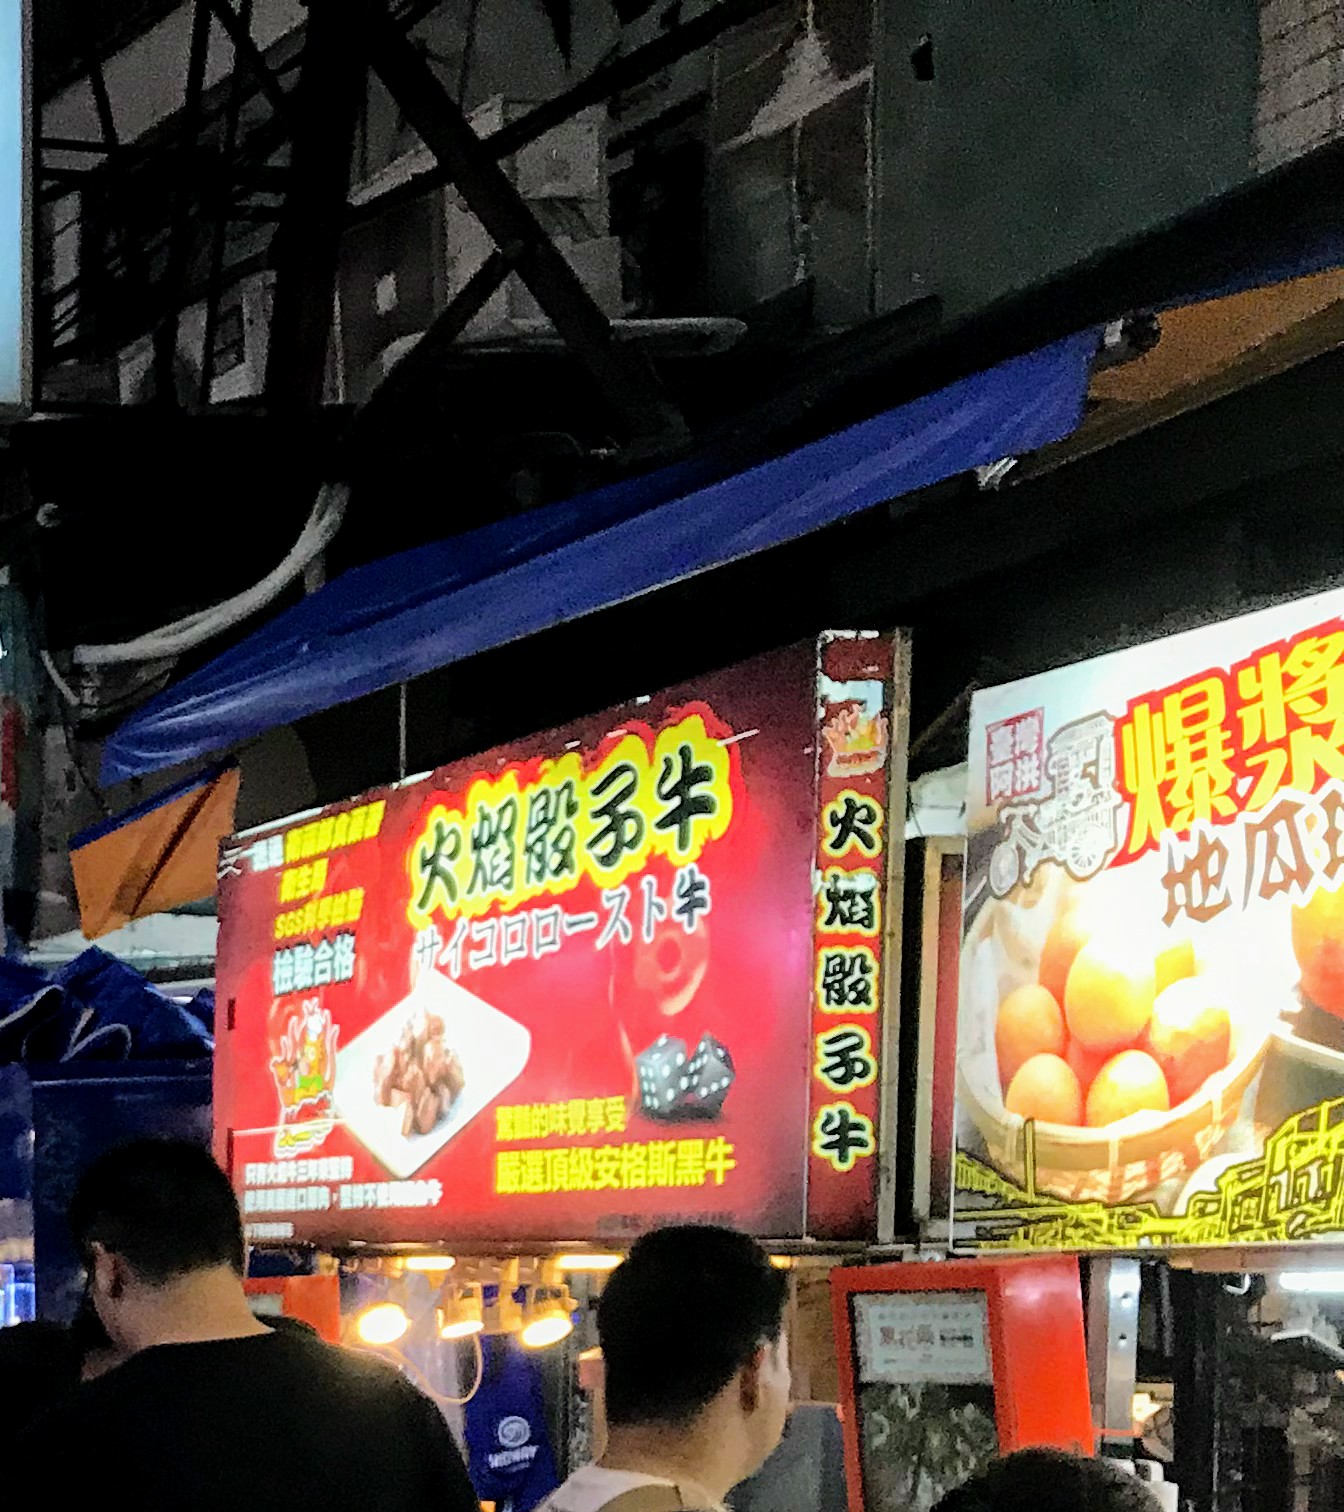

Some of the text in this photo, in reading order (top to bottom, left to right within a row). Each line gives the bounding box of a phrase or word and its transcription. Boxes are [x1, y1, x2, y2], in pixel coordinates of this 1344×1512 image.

[417, 744, 718, 911] 火焰骰子牛
[406, 868, 710, 980] サイコロロースト牛
